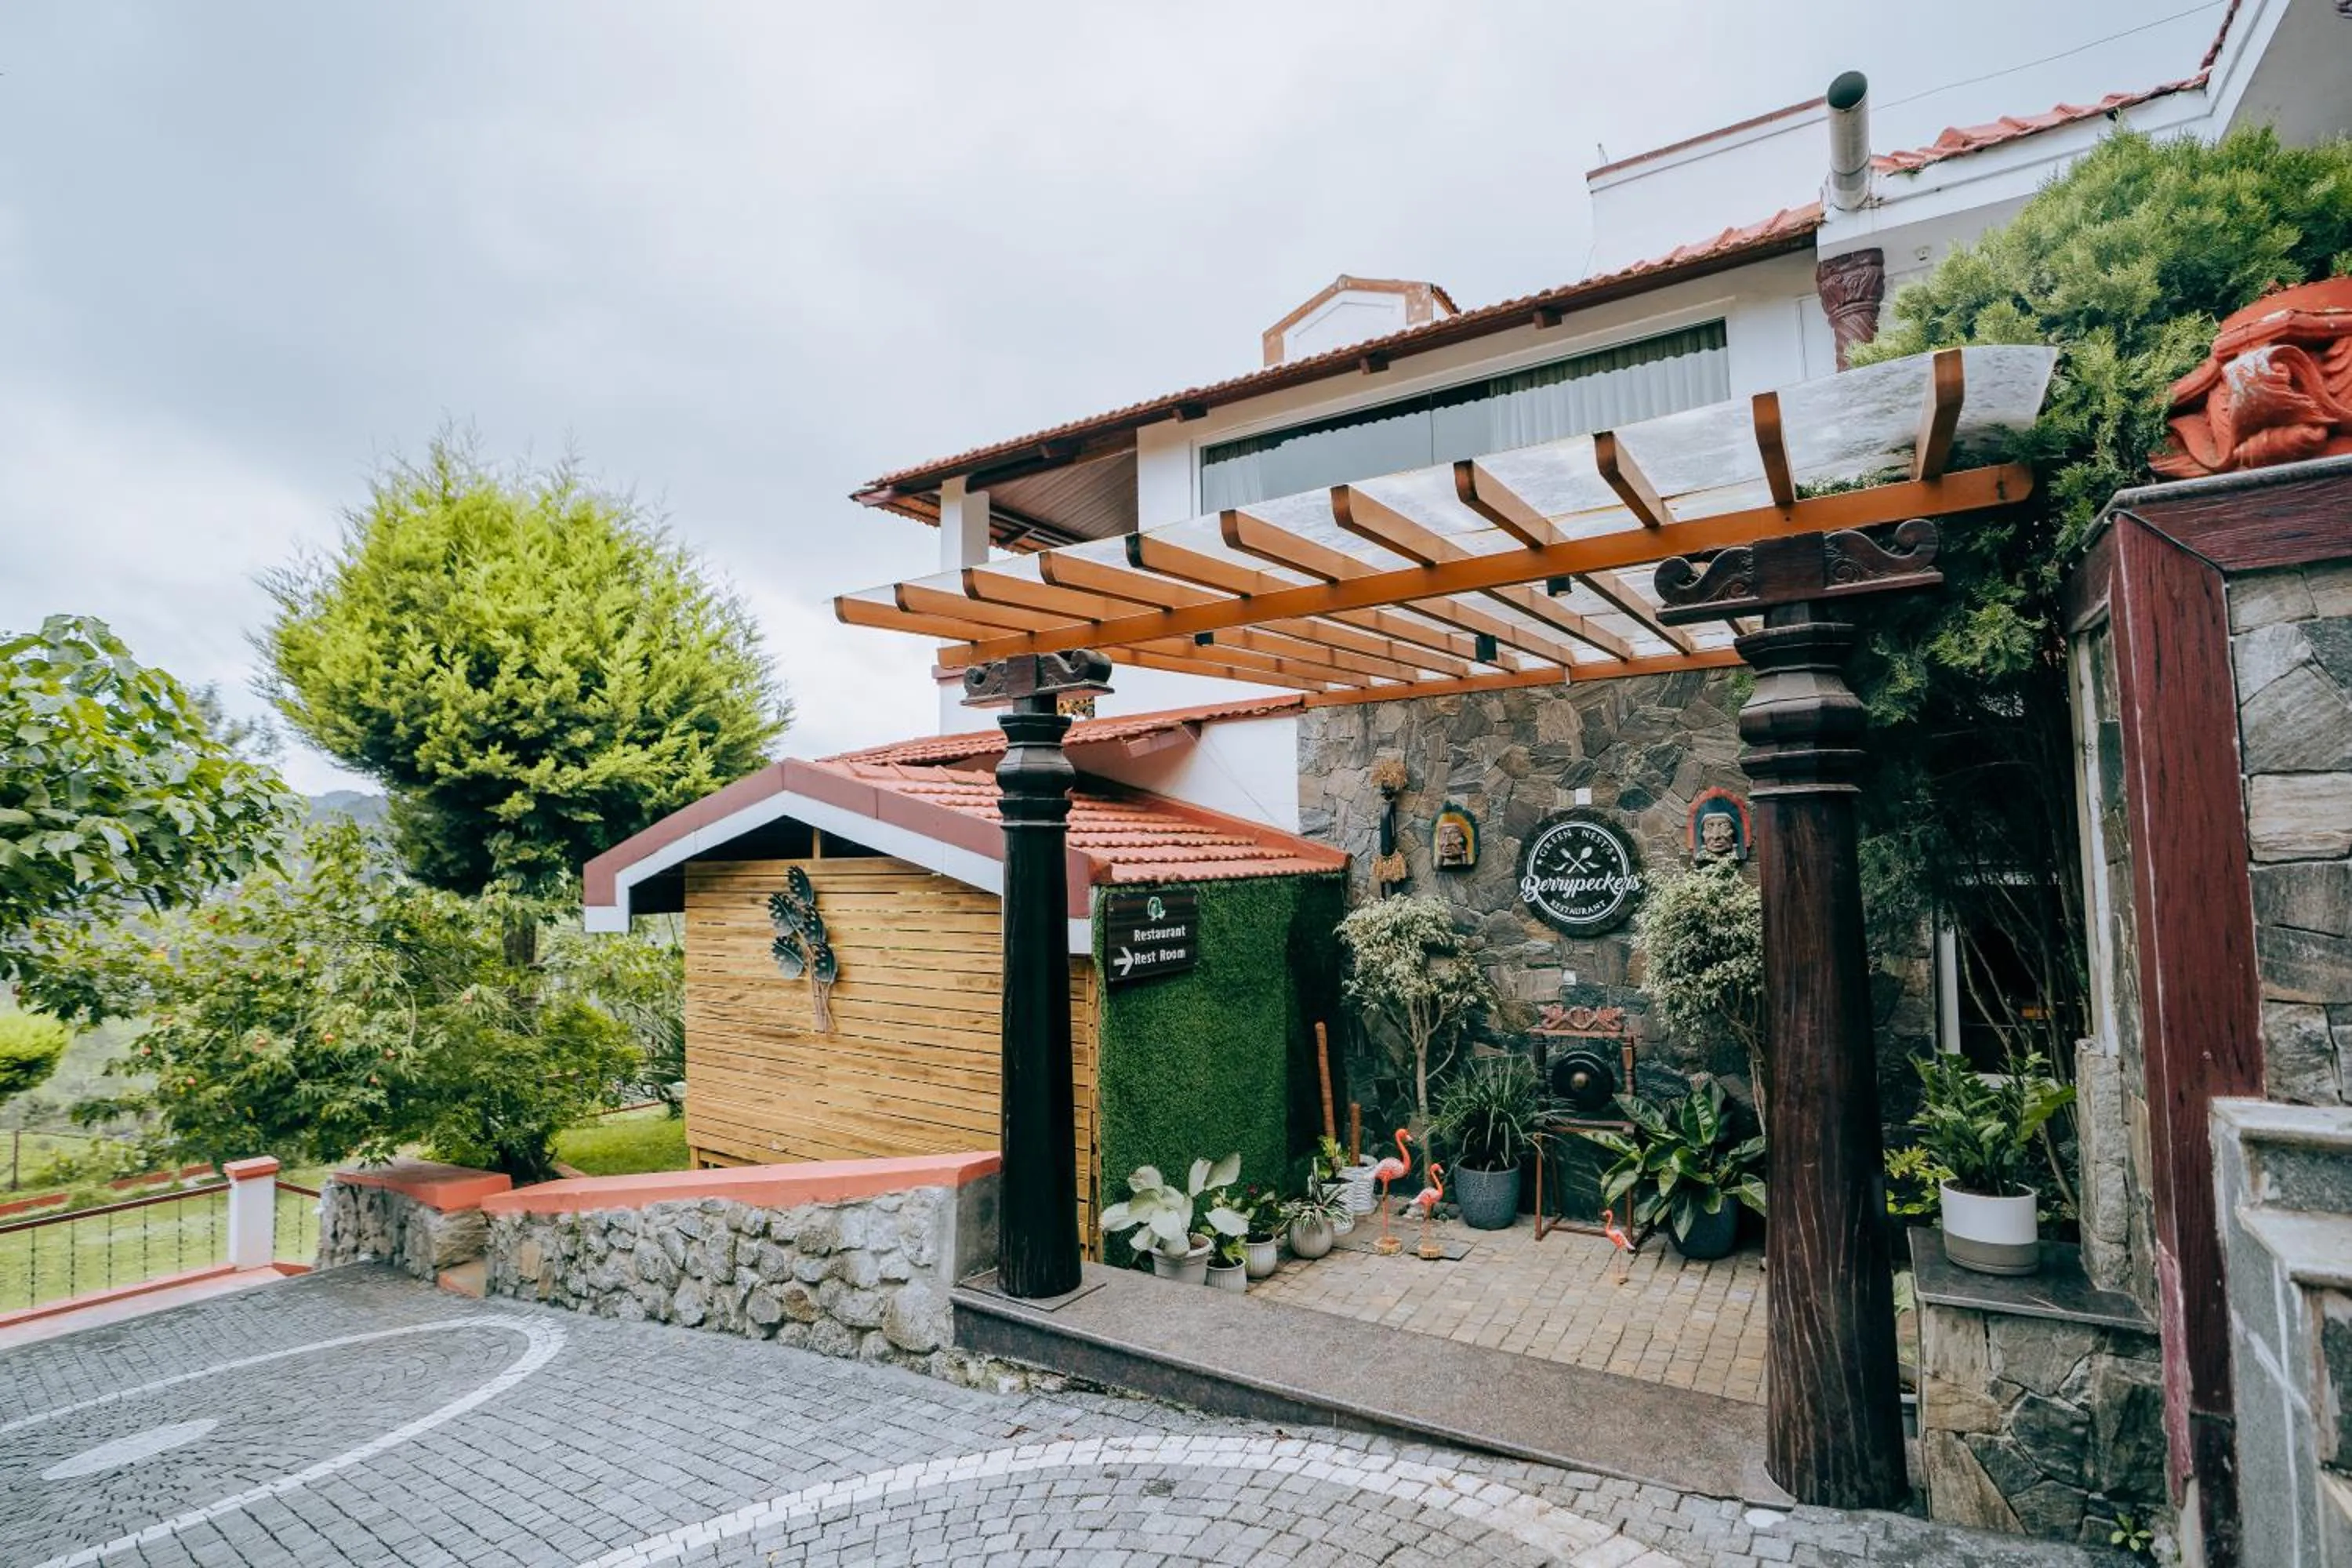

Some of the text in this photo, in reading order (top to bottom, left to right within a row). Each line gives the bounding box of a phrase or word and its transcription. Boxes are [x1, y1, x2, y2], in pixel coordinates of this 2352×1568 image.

[1539, 829, 1573, 857] GREEN
[1520, 869, 1642, 902] Berrypeckers
[1550, 899, 1606, 915] RESTAURANT
[1134, 925, 1186, 942] Restaurant
[1134, 949, 1186, 965] Rest Room
